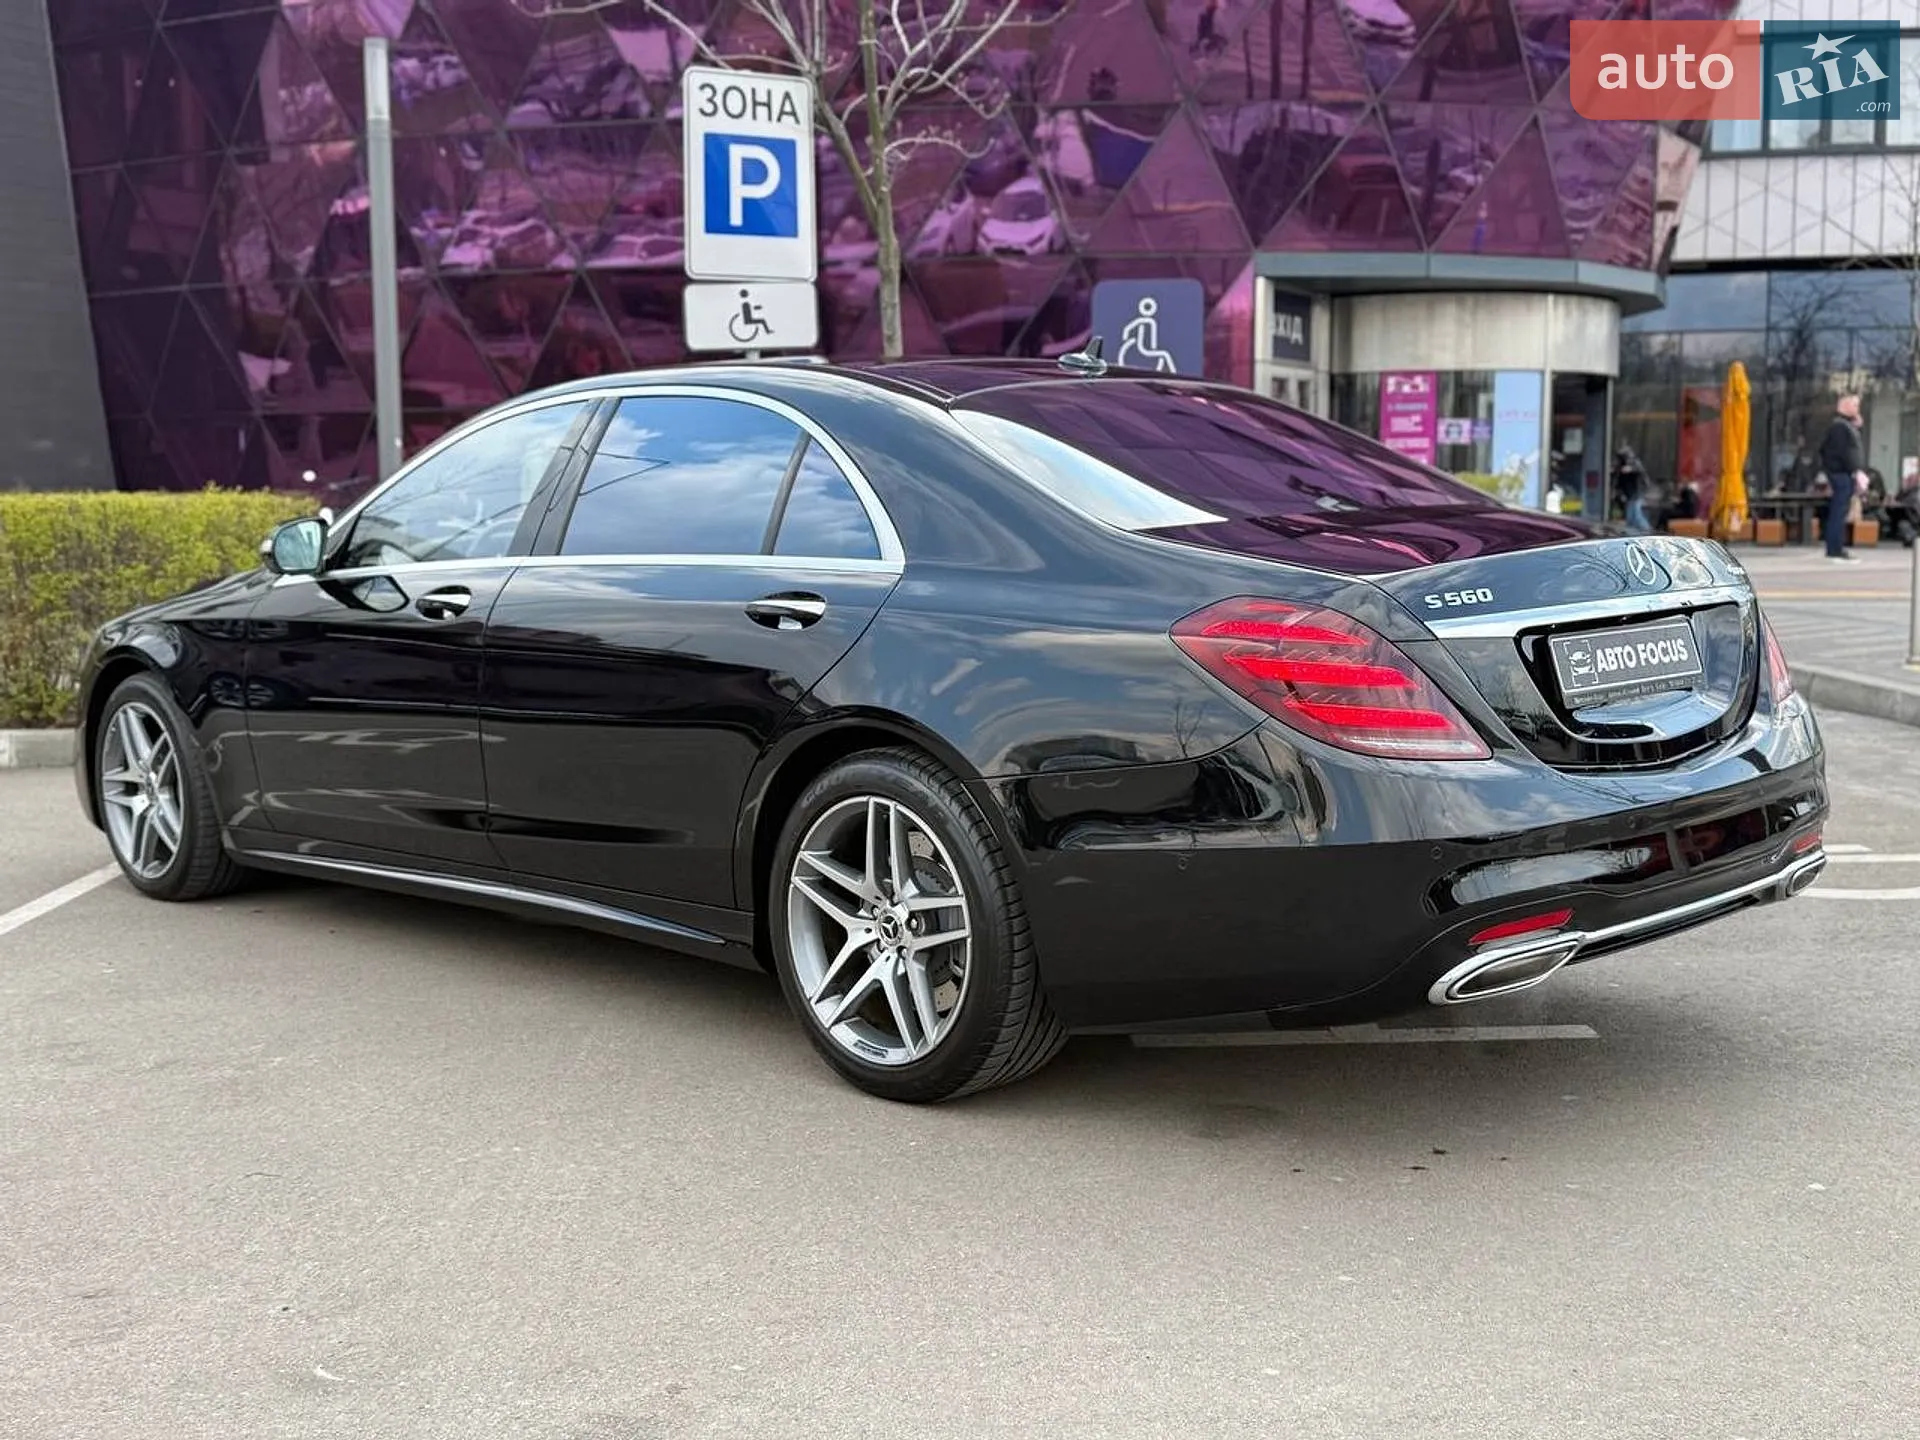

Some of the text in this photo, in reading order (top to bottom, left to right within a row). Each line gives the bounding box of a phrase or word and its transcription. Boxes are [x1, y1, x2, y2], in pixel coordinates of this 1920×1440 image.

[698, 83, 801, 125] ЗОНА
[728, 143, 782, 227] P
[1424, 587, 1494, 609] S 560
[1596, 638, 1690, 673] АВТО FOCUS
